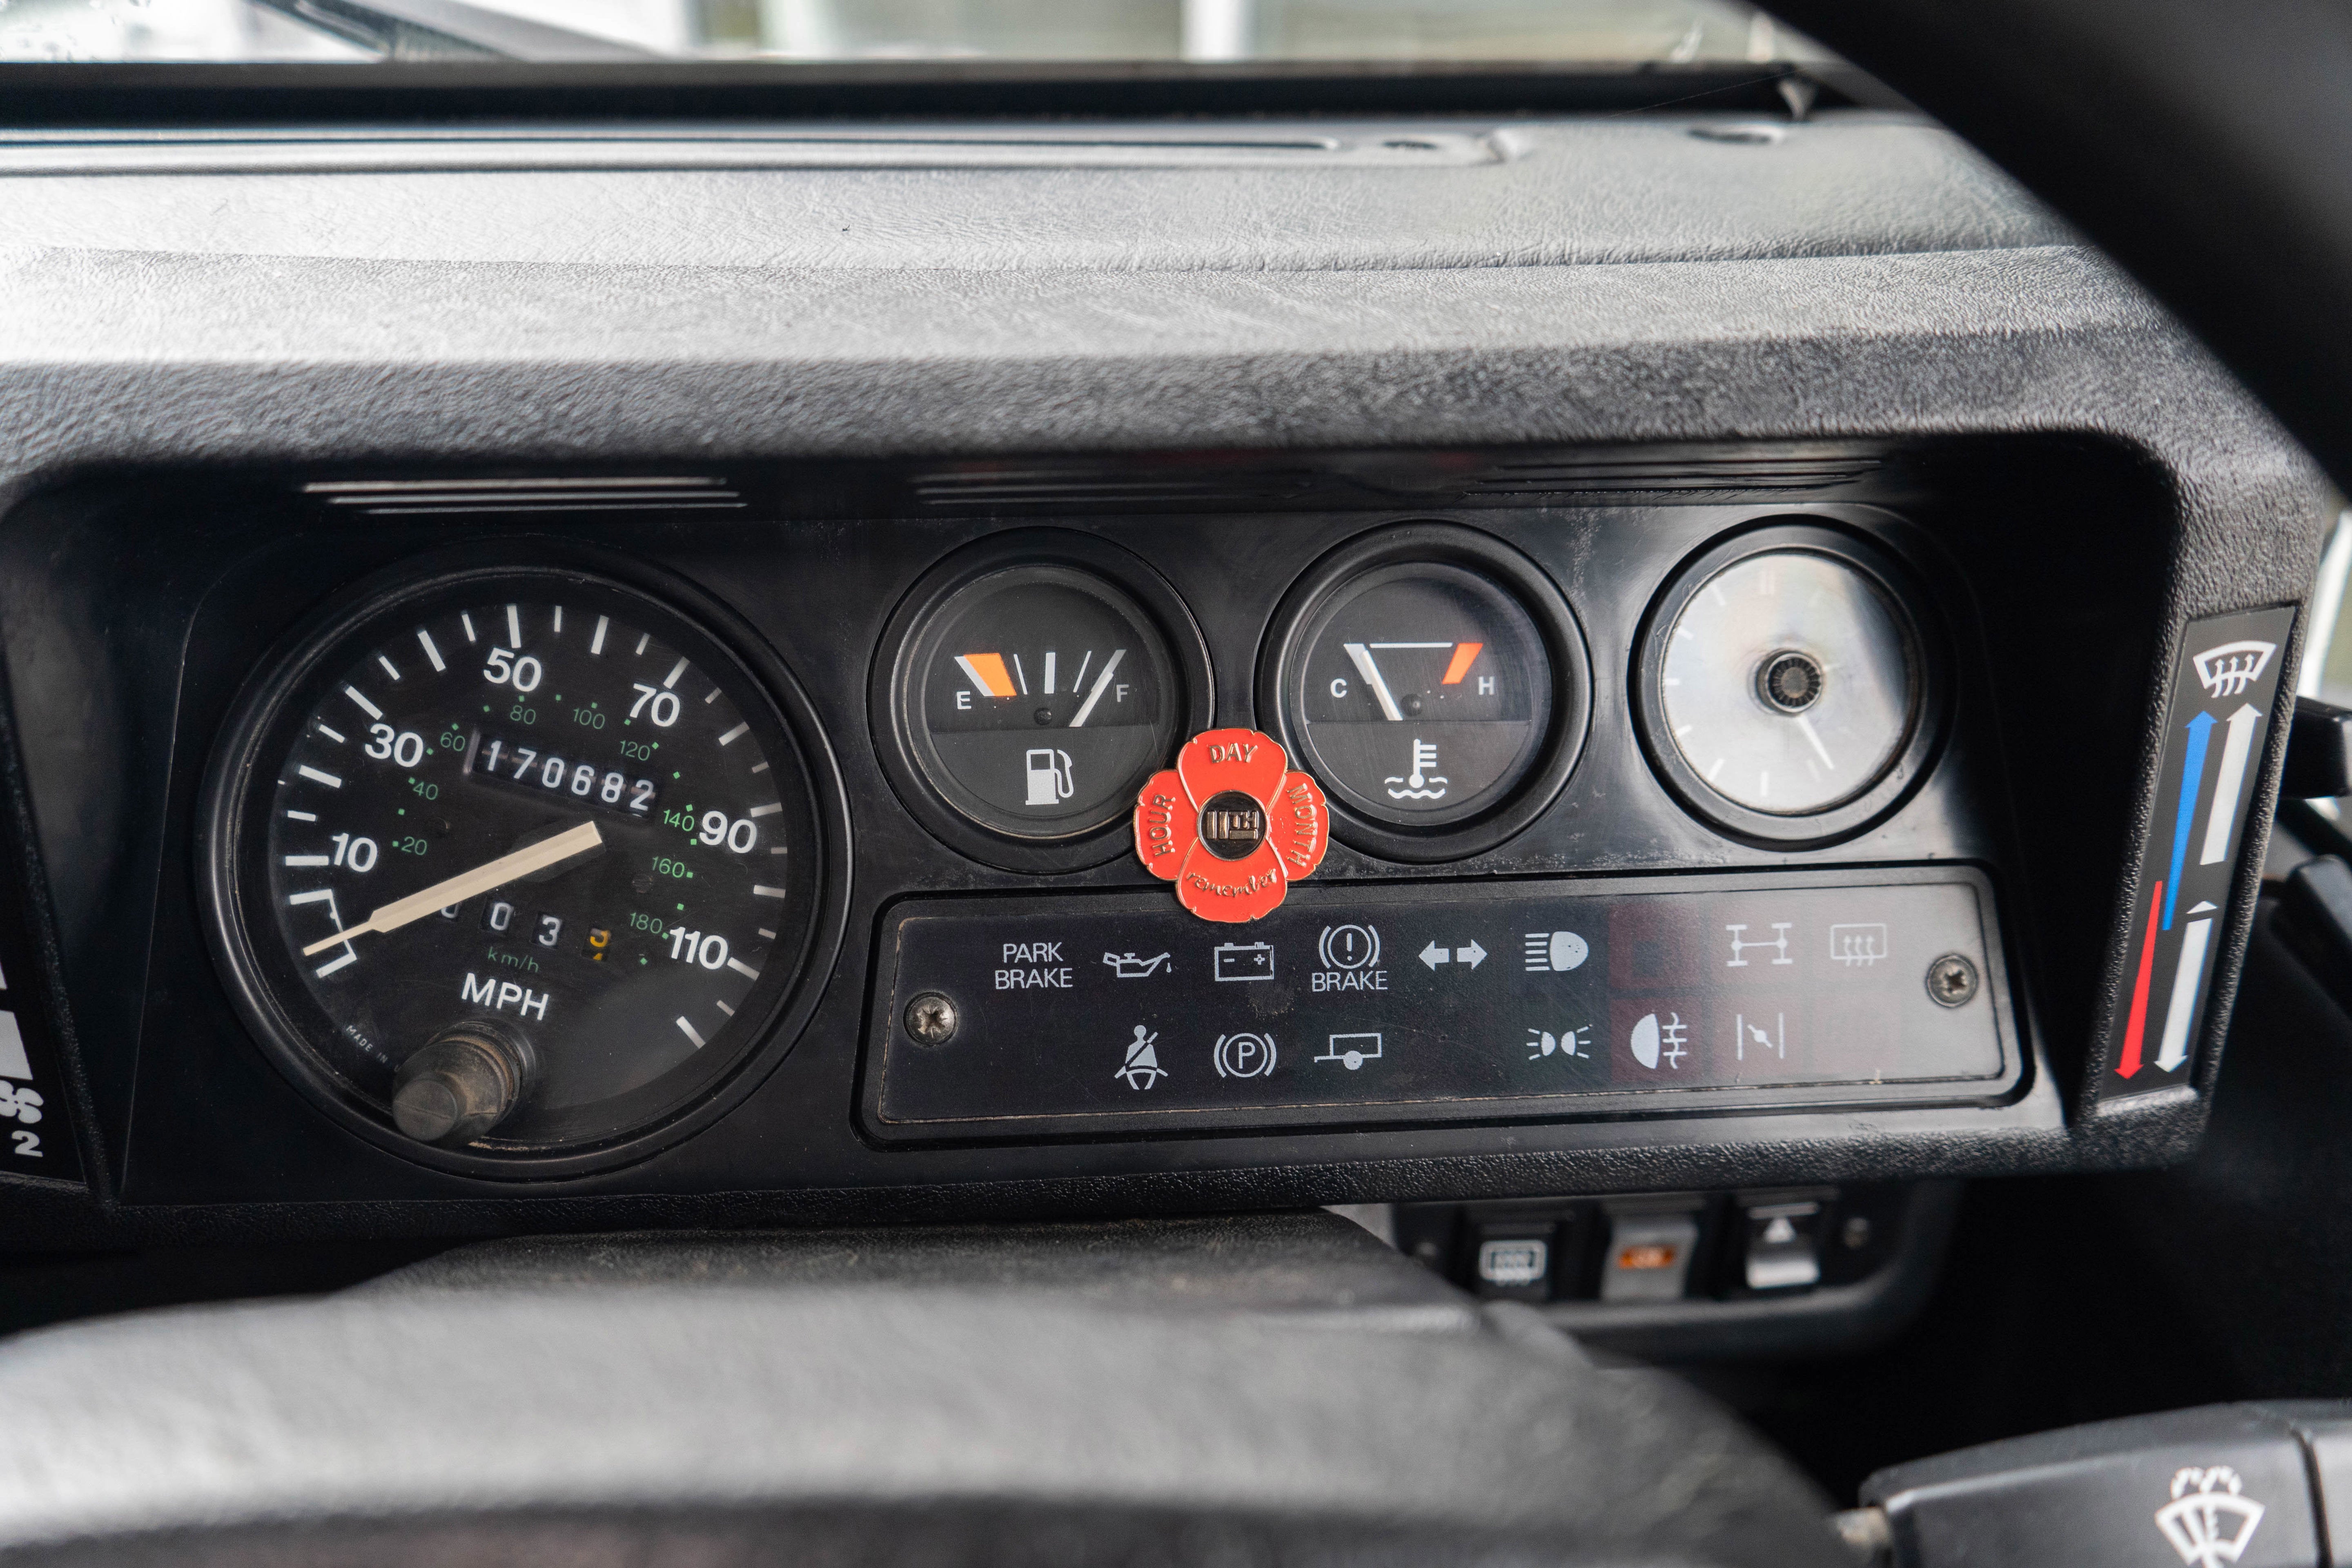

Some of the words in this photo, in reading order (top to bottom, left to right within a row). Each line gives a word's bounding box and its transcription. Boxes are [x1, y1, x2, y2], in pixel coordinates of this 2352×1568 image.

[483, 647, 541, 692] 50
[1116, 684, 1129, 702] F
[1330, 678, 1348, 698] C
[1478, 676, 1495, 695] H
[630, 683, 680, 727] 70
[957, 691, 971, 710] E
[510, 705, 537, 725] 80
[573, 708, 605, 730] 100
[365, 723, 423, 768] 30
[440, 732, 466, 751] 60
[619, 740, 650, 761] 120
[1209, 743, 1258, 764] DAY
[488, 739, 655, 811] 170682
[412, 782, 439, 800] 40
[663, 809, 695, 832] 140
[699, 811, 757, 853] 90
[1149, 793, 1176, 857] HOUR
[1287, 783, 1318, 868] MONTH
[331, 833, 378, 873] 10
[401, 836, 428, 855] 20
[652, 856, 685, 878] 160
[1186, 868, 1277, 898] remember
[629, 912, 663, 934] 180
[487, 946, 540, 973] km/h
[669, 926, 728, 970] 110
[1003, 942, 1064, 963] PARK
[995, 967, 1074, 990] BRAKE
[1311, 970, 1388, 992] BRAKE
[461, 972, 549, 1021] MPH
[346, 1025, 373, 1052] MADE
[1238, 1041, 1256, 1069] P
[11, 1129, 44, 1157] 2
